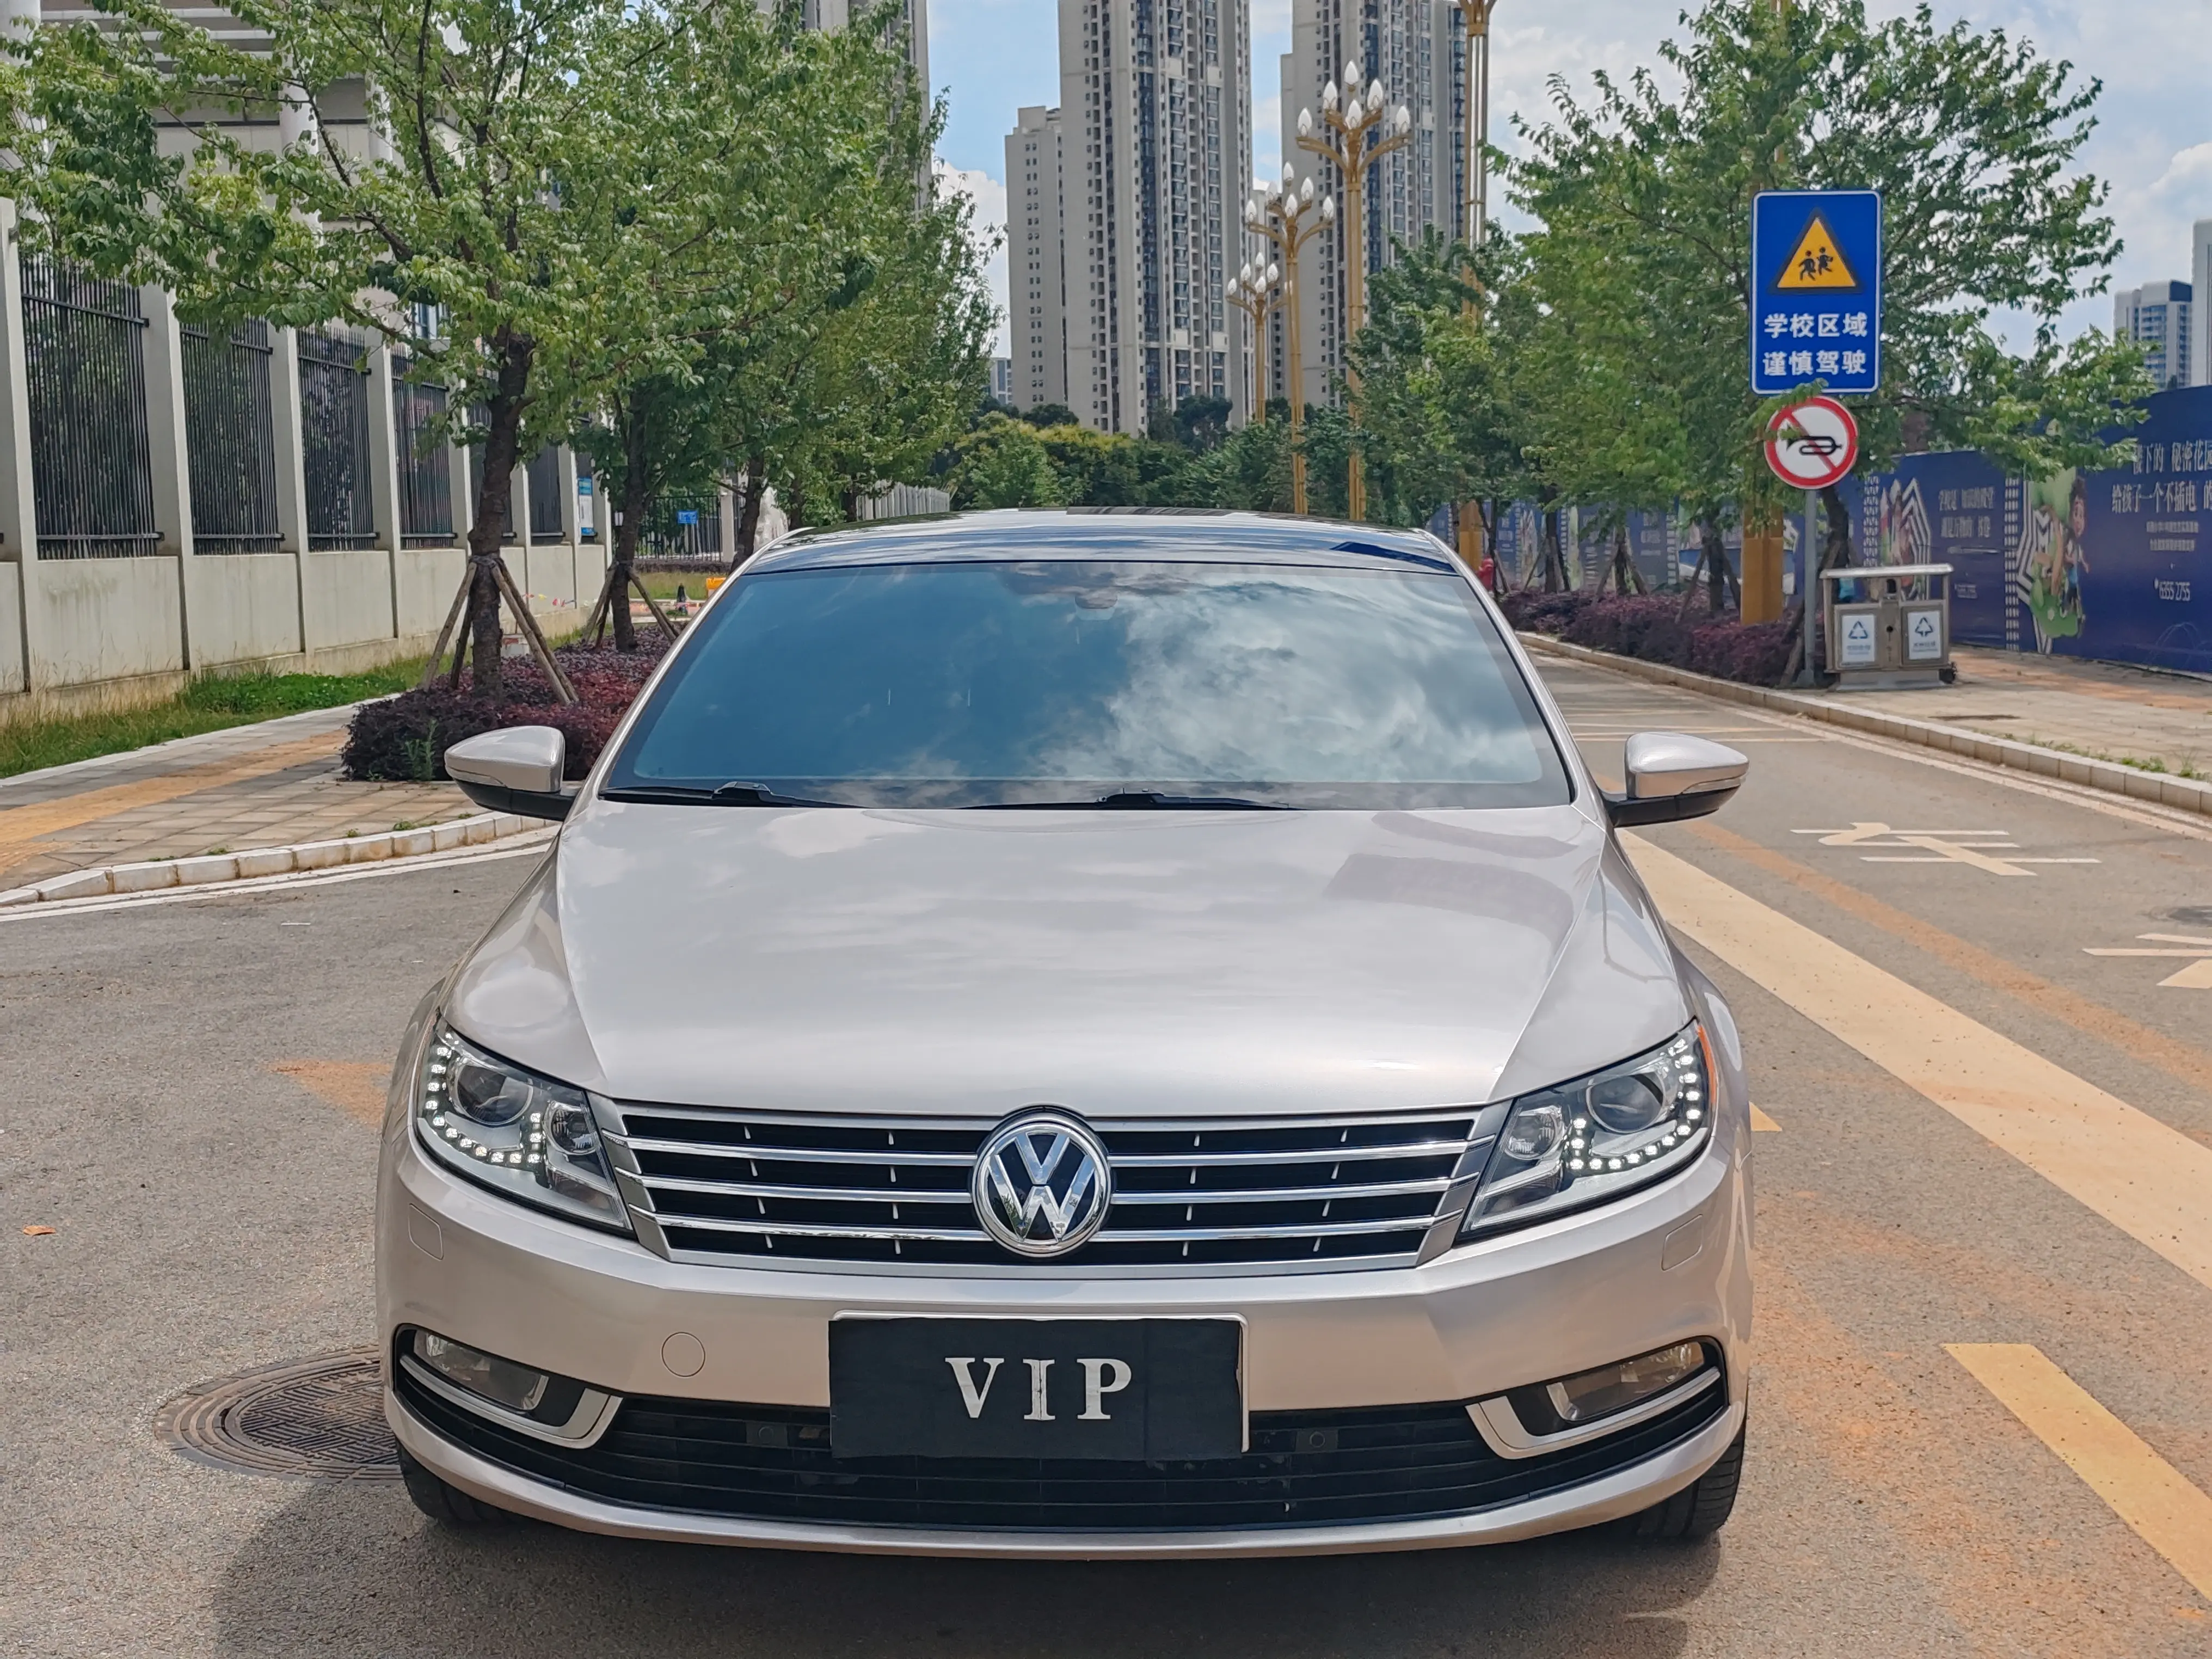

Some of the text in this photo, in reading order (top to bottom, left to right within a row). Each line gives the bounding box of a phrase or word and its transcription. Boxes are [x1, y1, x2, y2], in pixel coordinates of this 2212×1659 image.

[1764, 312, 1867, 339] 学校区域
[1762, 349, 1867, 376] 谨慎驾驶
[944, 1357, 1132, 1421] VIP
